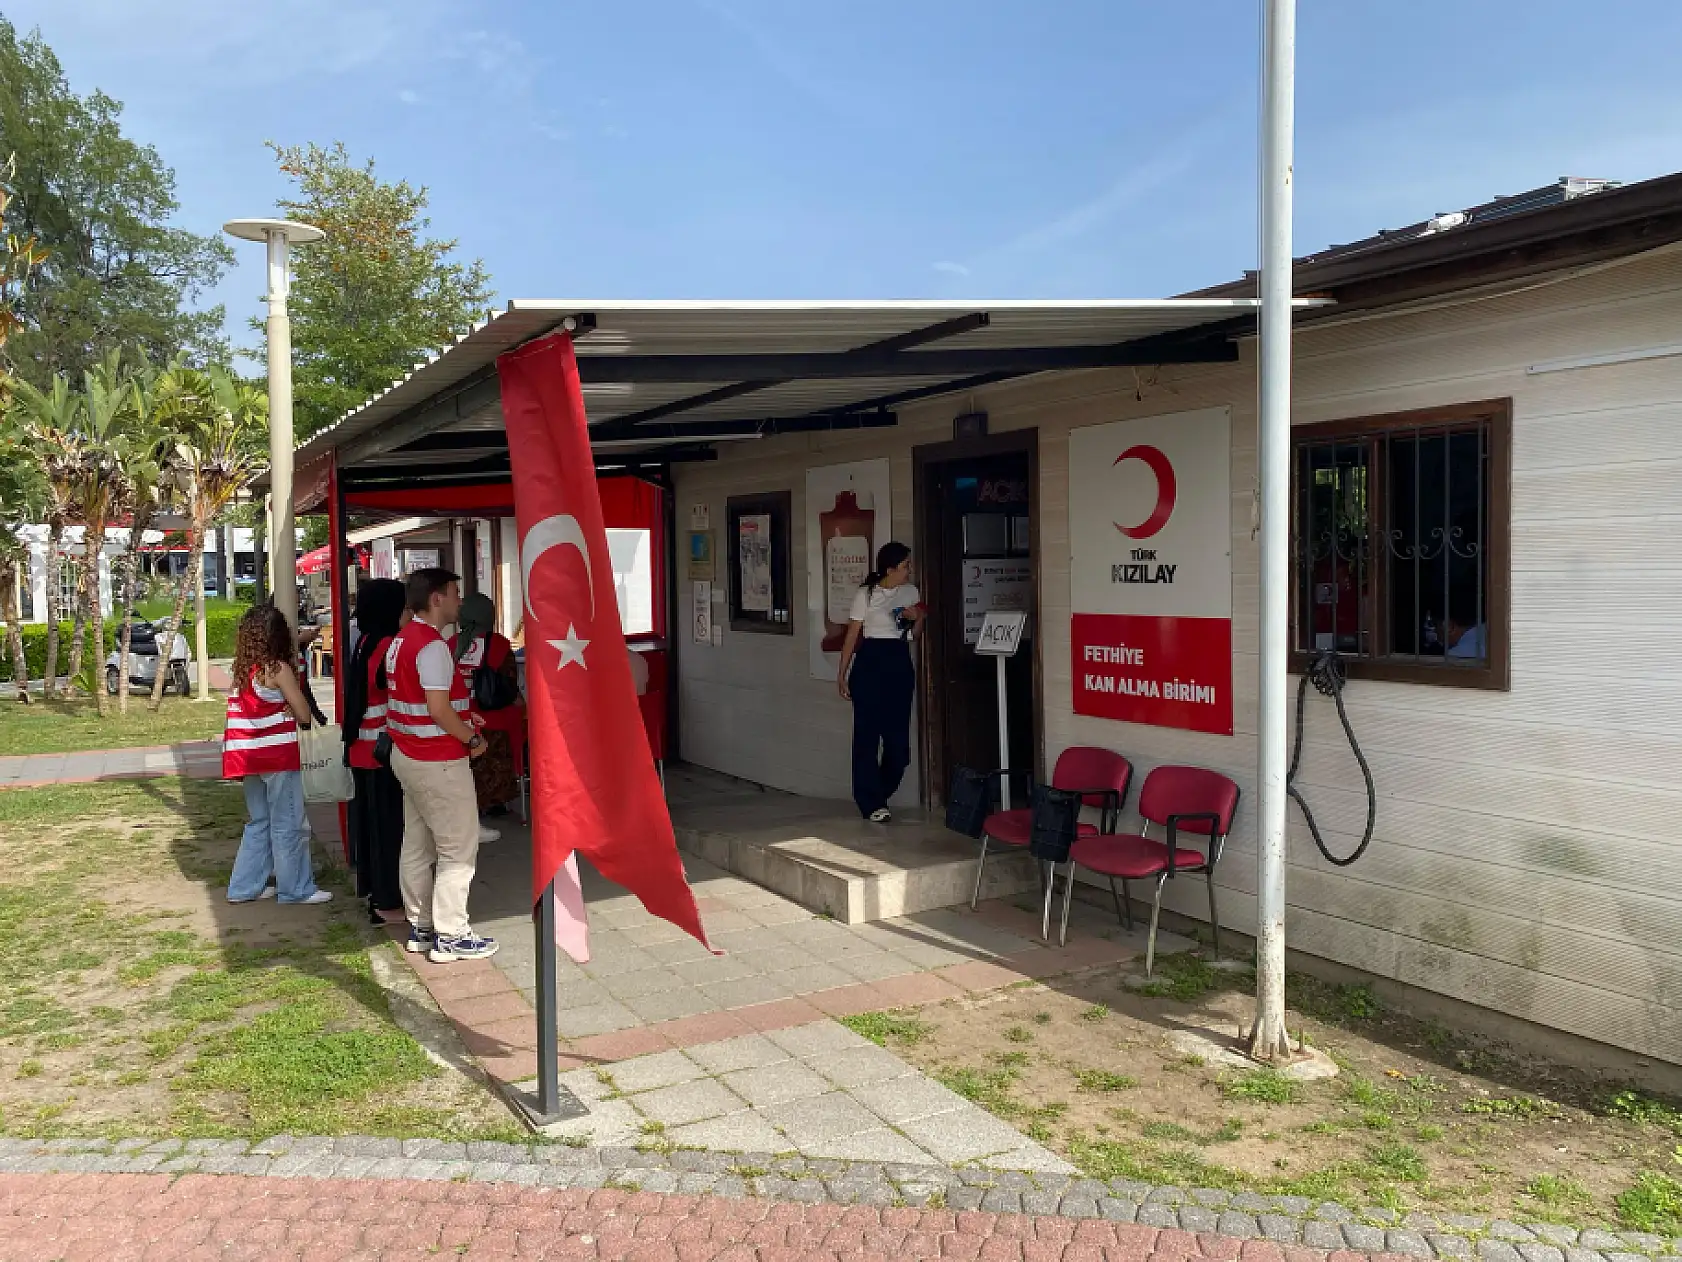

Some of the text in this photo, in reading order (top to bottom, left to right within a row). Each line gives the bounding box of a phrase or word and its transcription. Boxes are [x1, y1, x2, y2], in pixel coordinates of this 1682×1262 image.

[1129, 548, 1157, 561] TÜRK
[1111, 564, 1178, 583] KIZILAY
[1084, 642, 1144, 666] FETHİYE
[1084, 673, 1114, 693] KAN
[1117, 677, 1160, 698] ALMA
